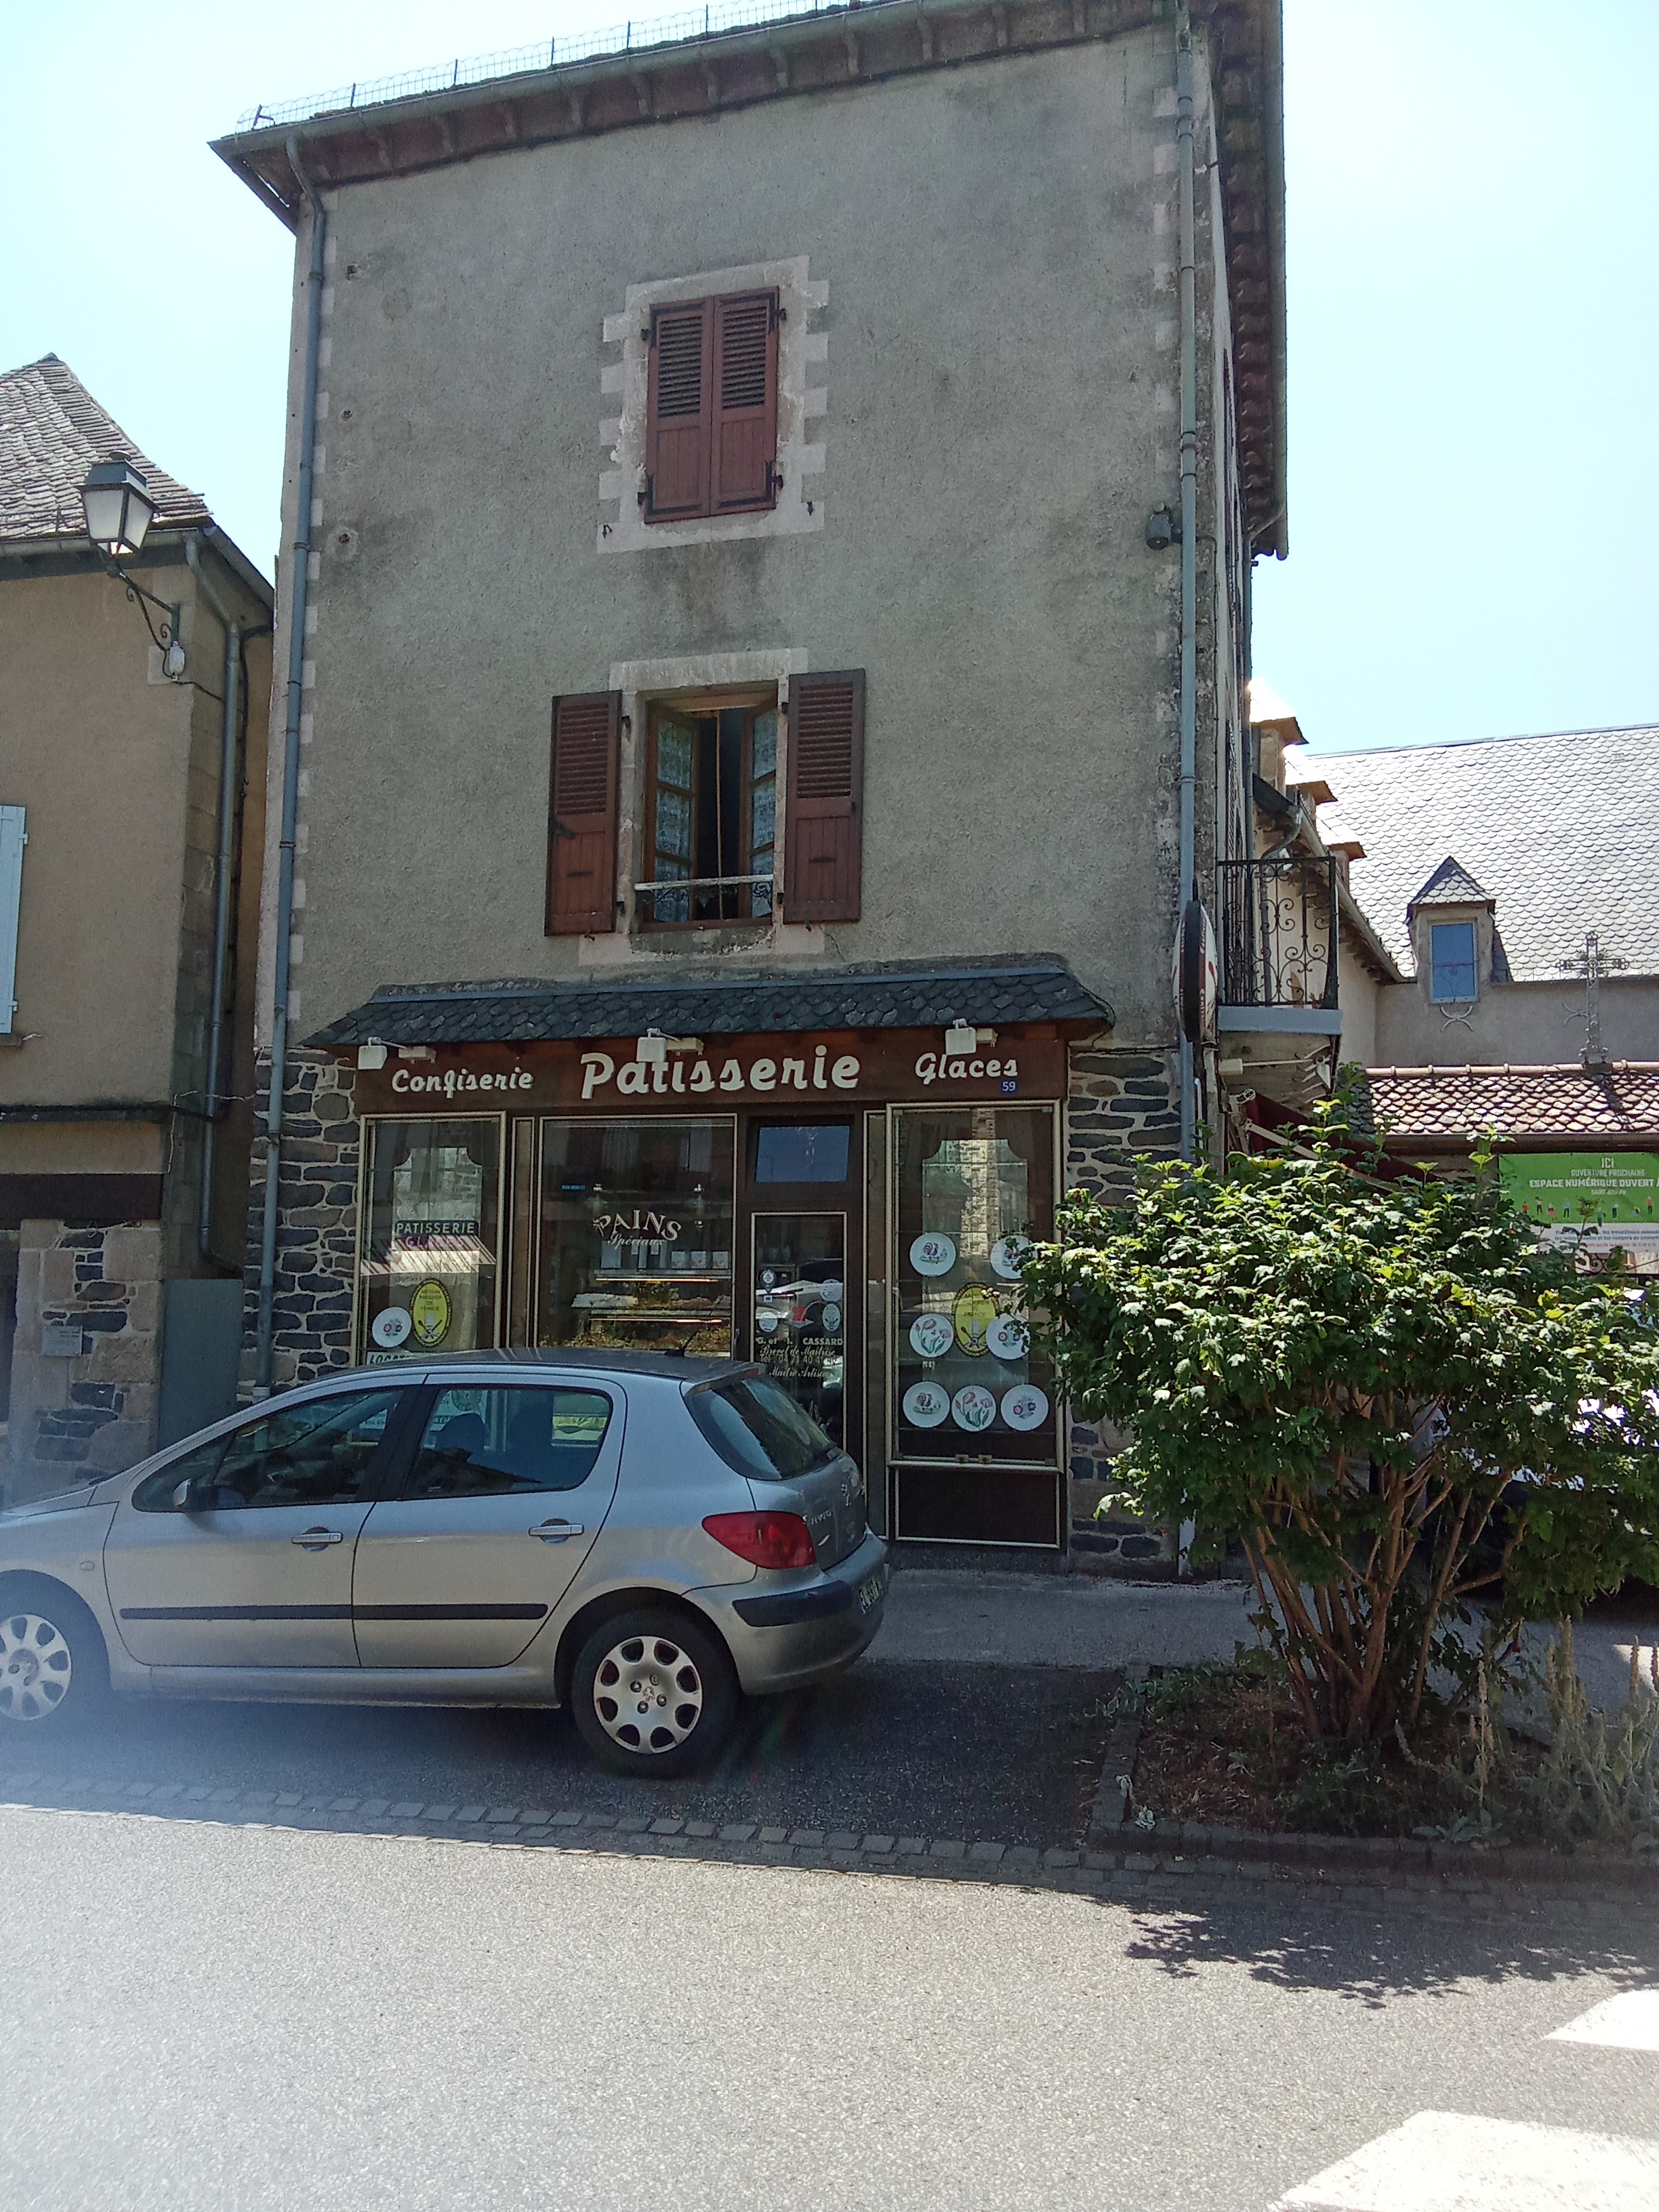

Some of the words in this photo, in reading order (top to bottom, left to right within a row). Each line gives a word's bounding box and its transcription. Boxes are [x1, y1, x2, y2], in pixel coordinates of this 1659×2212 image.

[915, 1052, 1018, 1084] Glaces
[392, 1067, 534, 1099] Confiserie
[1002, 1081, 1017, 1092] 59
[1601, 1158, 1614, 1168] ICI
[1529, 1179, 1563, 1187] ESPACE
[1565, 1177, 1618, 1187] NUMÉRIQUE
[1620, 1179, 1654, 1187] OUVERT
[396, 1223, 475, 1233] PATISSERIE
[592, 1210, 682, 1241] PAINS
[802, 1337, 843, 1345] CASSARD
[790, 1345, 800, 1355] de
[779, 1354, 788, 1363] 04
[803, 1355, 813, 1364] 40
